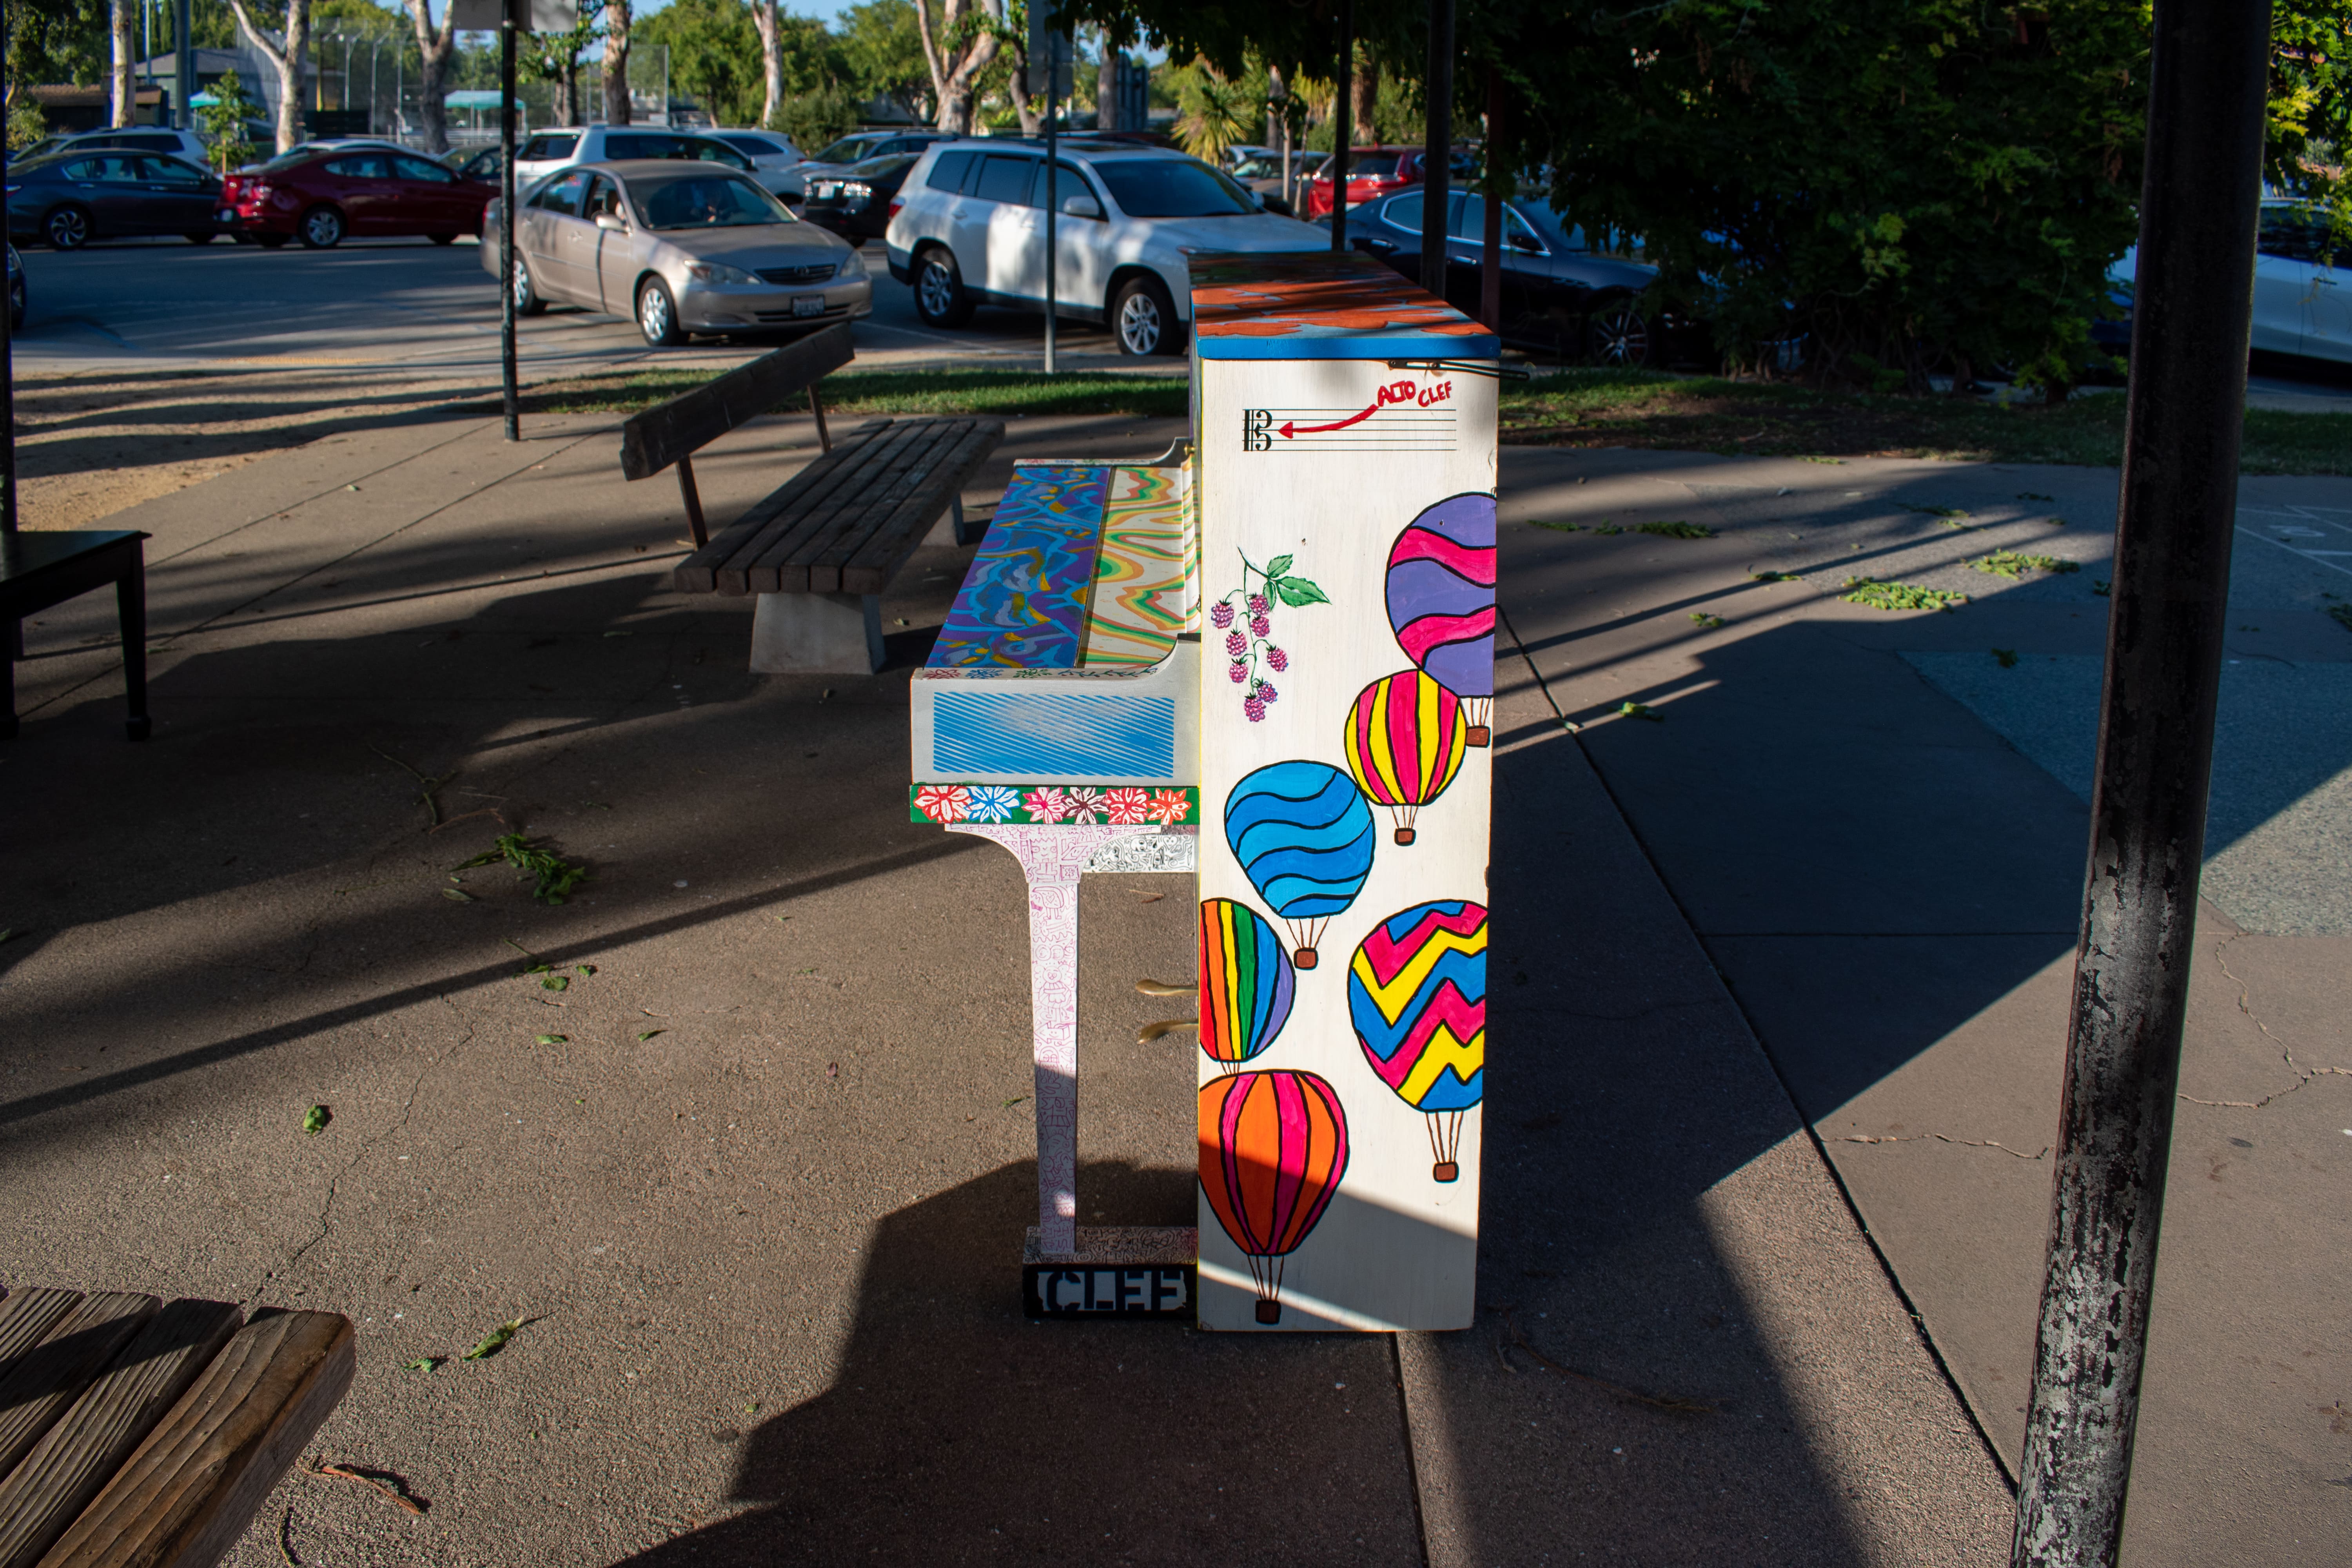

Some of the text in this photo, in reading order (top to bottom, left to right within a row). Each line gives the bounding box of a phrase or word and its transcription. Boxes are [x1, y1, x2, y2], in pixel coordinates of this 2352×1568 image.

[1377, 380, 1452, 407] ALTO CLEF
[1046, 1271, 1181, 1311] CLEF
